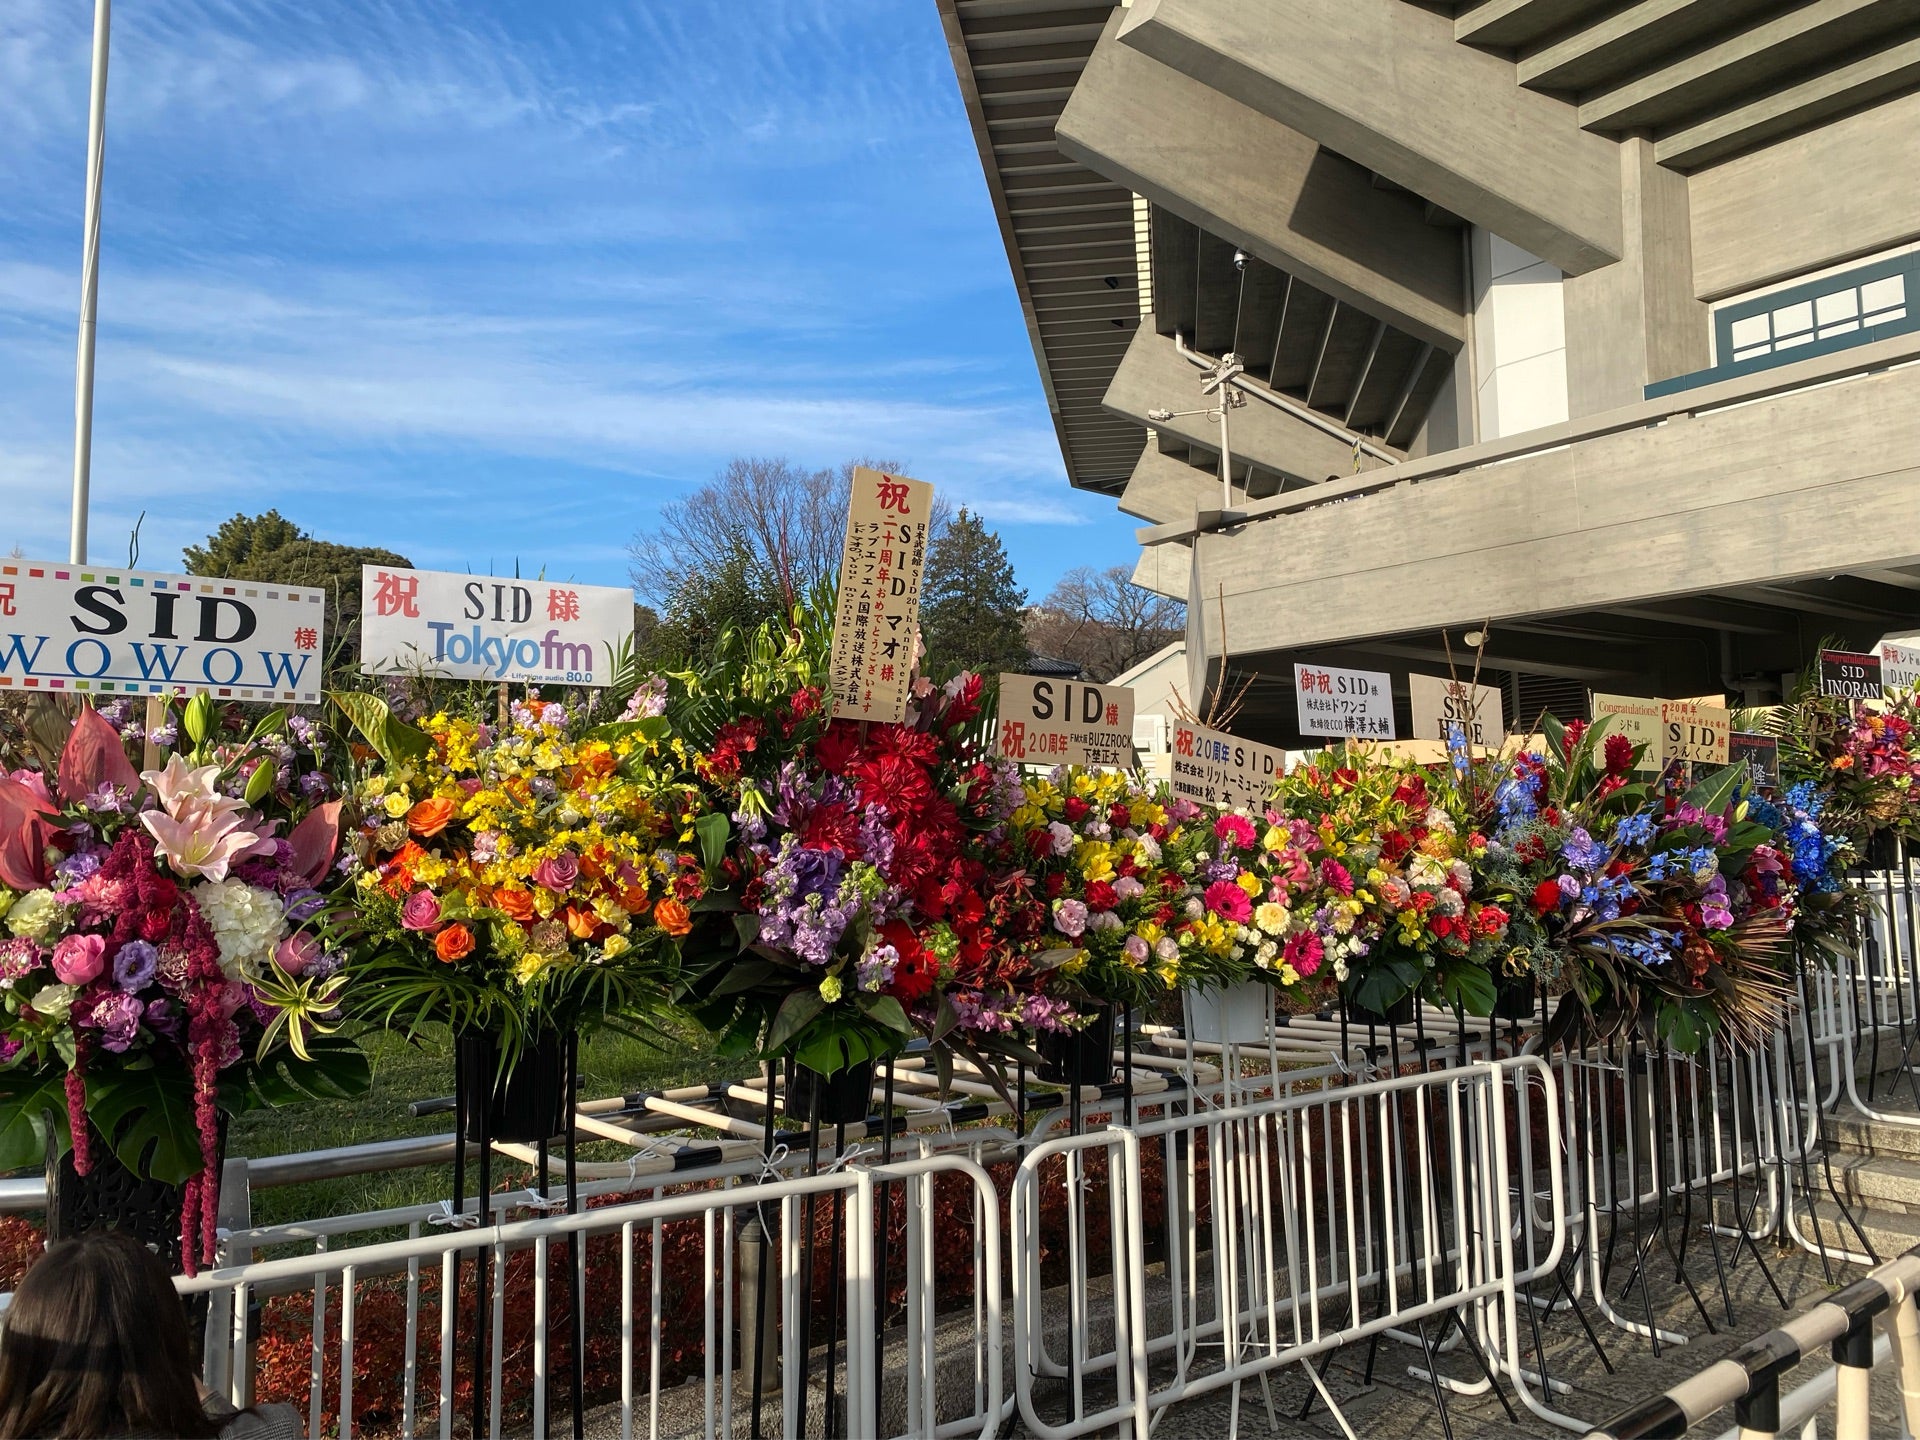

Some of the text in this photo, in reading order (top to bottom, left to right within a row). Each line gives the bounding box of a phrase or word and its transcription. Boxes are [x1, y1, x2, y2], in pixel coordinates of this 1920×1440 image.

[876, 474, 911, 515] 祝
[372, 571, 580, 624] 祝 SID 様
[908, 569, 919, 595] SID
[69, 585, 318, 650] SID 様
[880, 524, 911, 682] SID マオ 様
[0, 633, 313, 690] WOWOW
[544, 674, 565, 682] audio
[566, 671, 593, 683] 80.0
[893, 626, 912, 721] Anniversary
[1841, 665, 1865, 679] SID
[1301, 668, 1379, 697] 御祝 SID 様
[1826, 679, 1880, 699] INORAN
[1032, 681, 1119, 726] SID 様
[1001, 719, 1069, 759] 祝 20周年
[1089, 731, 1132, 749] BUZZROCK
[1176, 727, 1194, 758] 祝
[1195, 736, 1231, 766] 20周年
[1234, 747, 1274, 775] SID
[1669, 722, 1715, 747] SID
